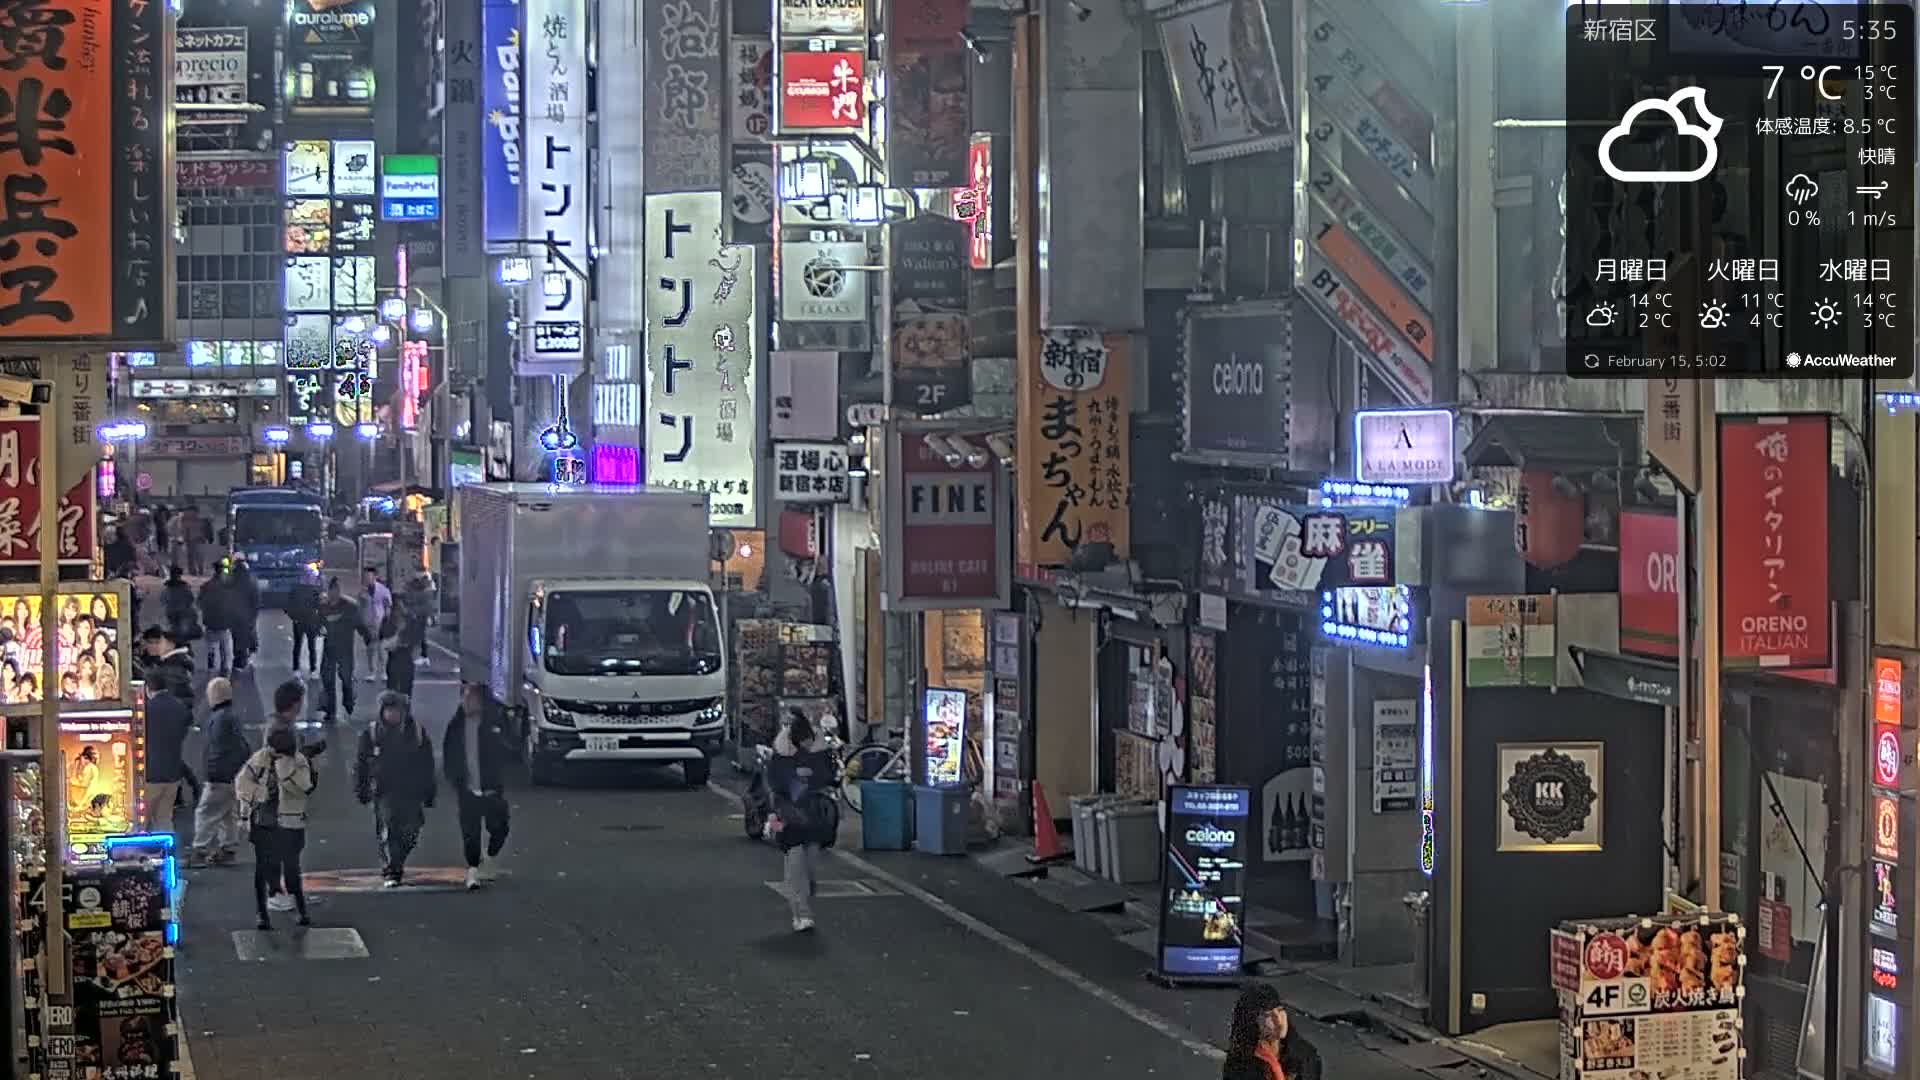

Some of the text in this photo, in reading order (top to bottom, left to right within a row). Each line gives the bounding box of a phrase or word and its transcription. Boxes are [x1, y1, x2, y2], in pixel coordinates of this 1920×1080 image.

[1314, 22, 1334, 42] 5
[830, 59, 859, 120] 牛門
[1313, 73, 1334, 92] 4
[1315, 122, 1334, 142] 3
[1314, 172, 1334, 193] 2
[1312, 268, 1340, 298] B1
[660, 209, 693, 462] トントン
[1212, 352, 1263, 394] celona
[71, 353, 92, 445] 通り一番街
[917, 386, 946, 404] 2F
[779, 450, 844, 471] 酒場心
[1041, 395, 1085, 548] まっちゃん
[779, 475, 844, 493] 新宿本店
[911, 485, 987, 513] FINE
[1350, 519, 1390, 535] フリー
[1754, 430, 1789, 604] 俺のイタリアン
[1647, 552, 1678, 592] OR
[1741, 616, 1808, 633] ORENO
[1740, 633, 1808, 651] ITALIAN
[1535, 782, 1564, 799] KK
[1186, 828, 1236, 843] celona
[1587, 985, 1619, 1008] 4F
